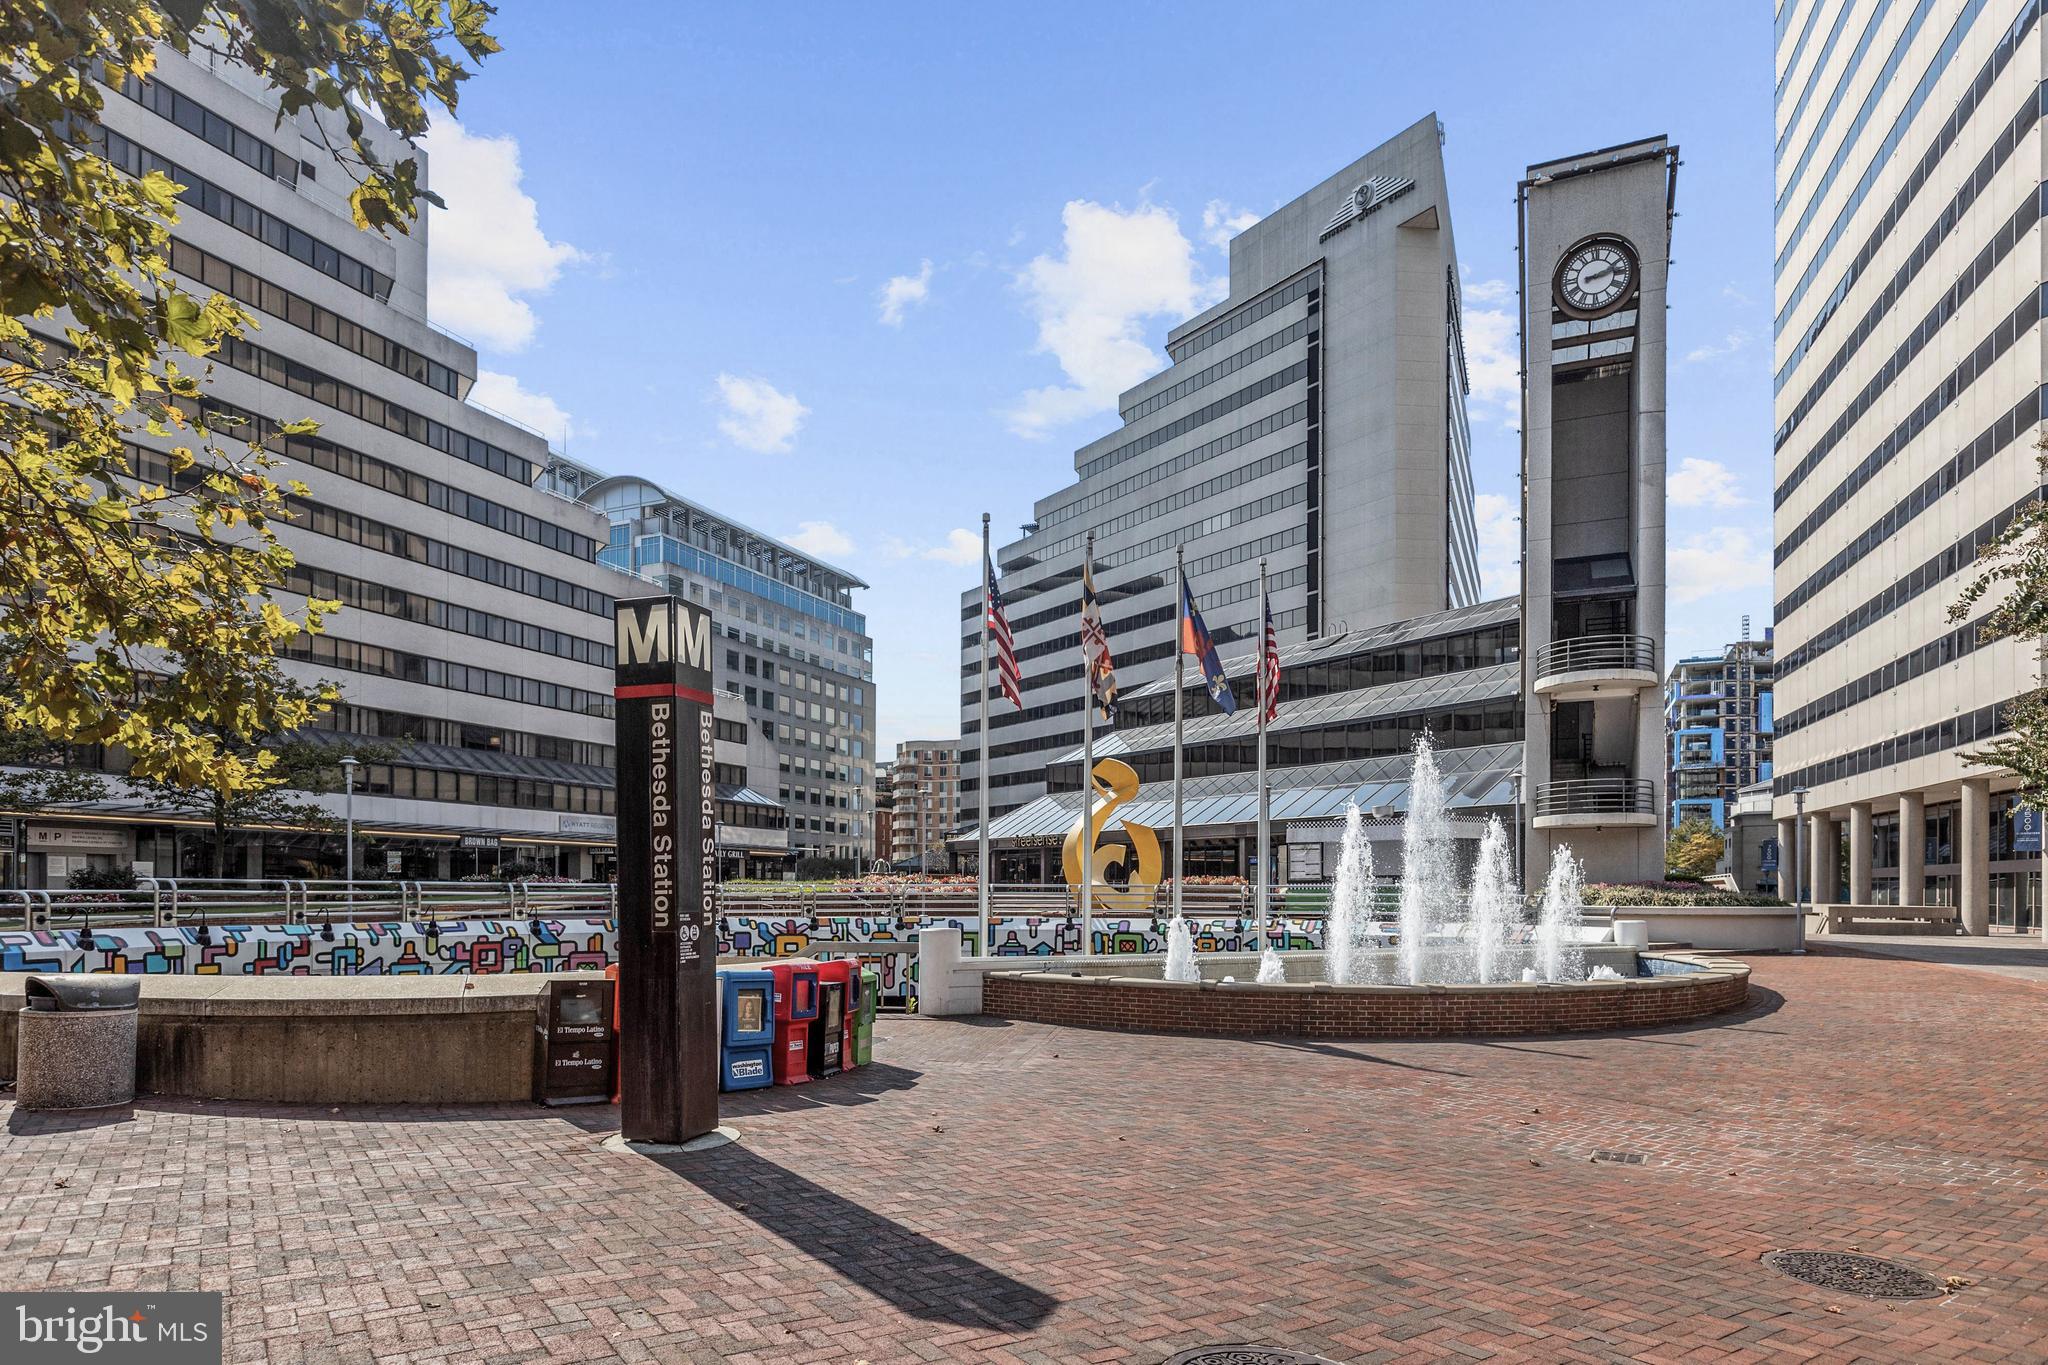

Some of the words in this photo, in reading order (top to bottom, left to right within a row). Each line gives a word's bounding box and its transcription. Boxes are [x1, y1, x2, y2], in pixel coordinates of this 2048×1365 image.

[617, 603, 669, 665] M
[677, 603, 711, 672] M
[651, 703, 671, 828] Bethesda
[700, 710, 713, 830] Bethesda
[38, 832, 47, 840] M
[54, 832, 62, 840] P
[464, 837, 485, 846] BROWN
[486, 838, 498, 847] BAG
[727, 850, 745, 858] GRILL
[653, 835, 672, 928] Station
[702, 841, 715, 927] Station
[557, 1026, 563, 1034] El
[564, 1026, 586, 1034] Tiempo
[555, 1059, 561, 1067] El
[562, 1059, 584, 1067] Tiempo
[584, 1058, 603, 1066] Latino
[739, 1067, 762, 1076] Blade
